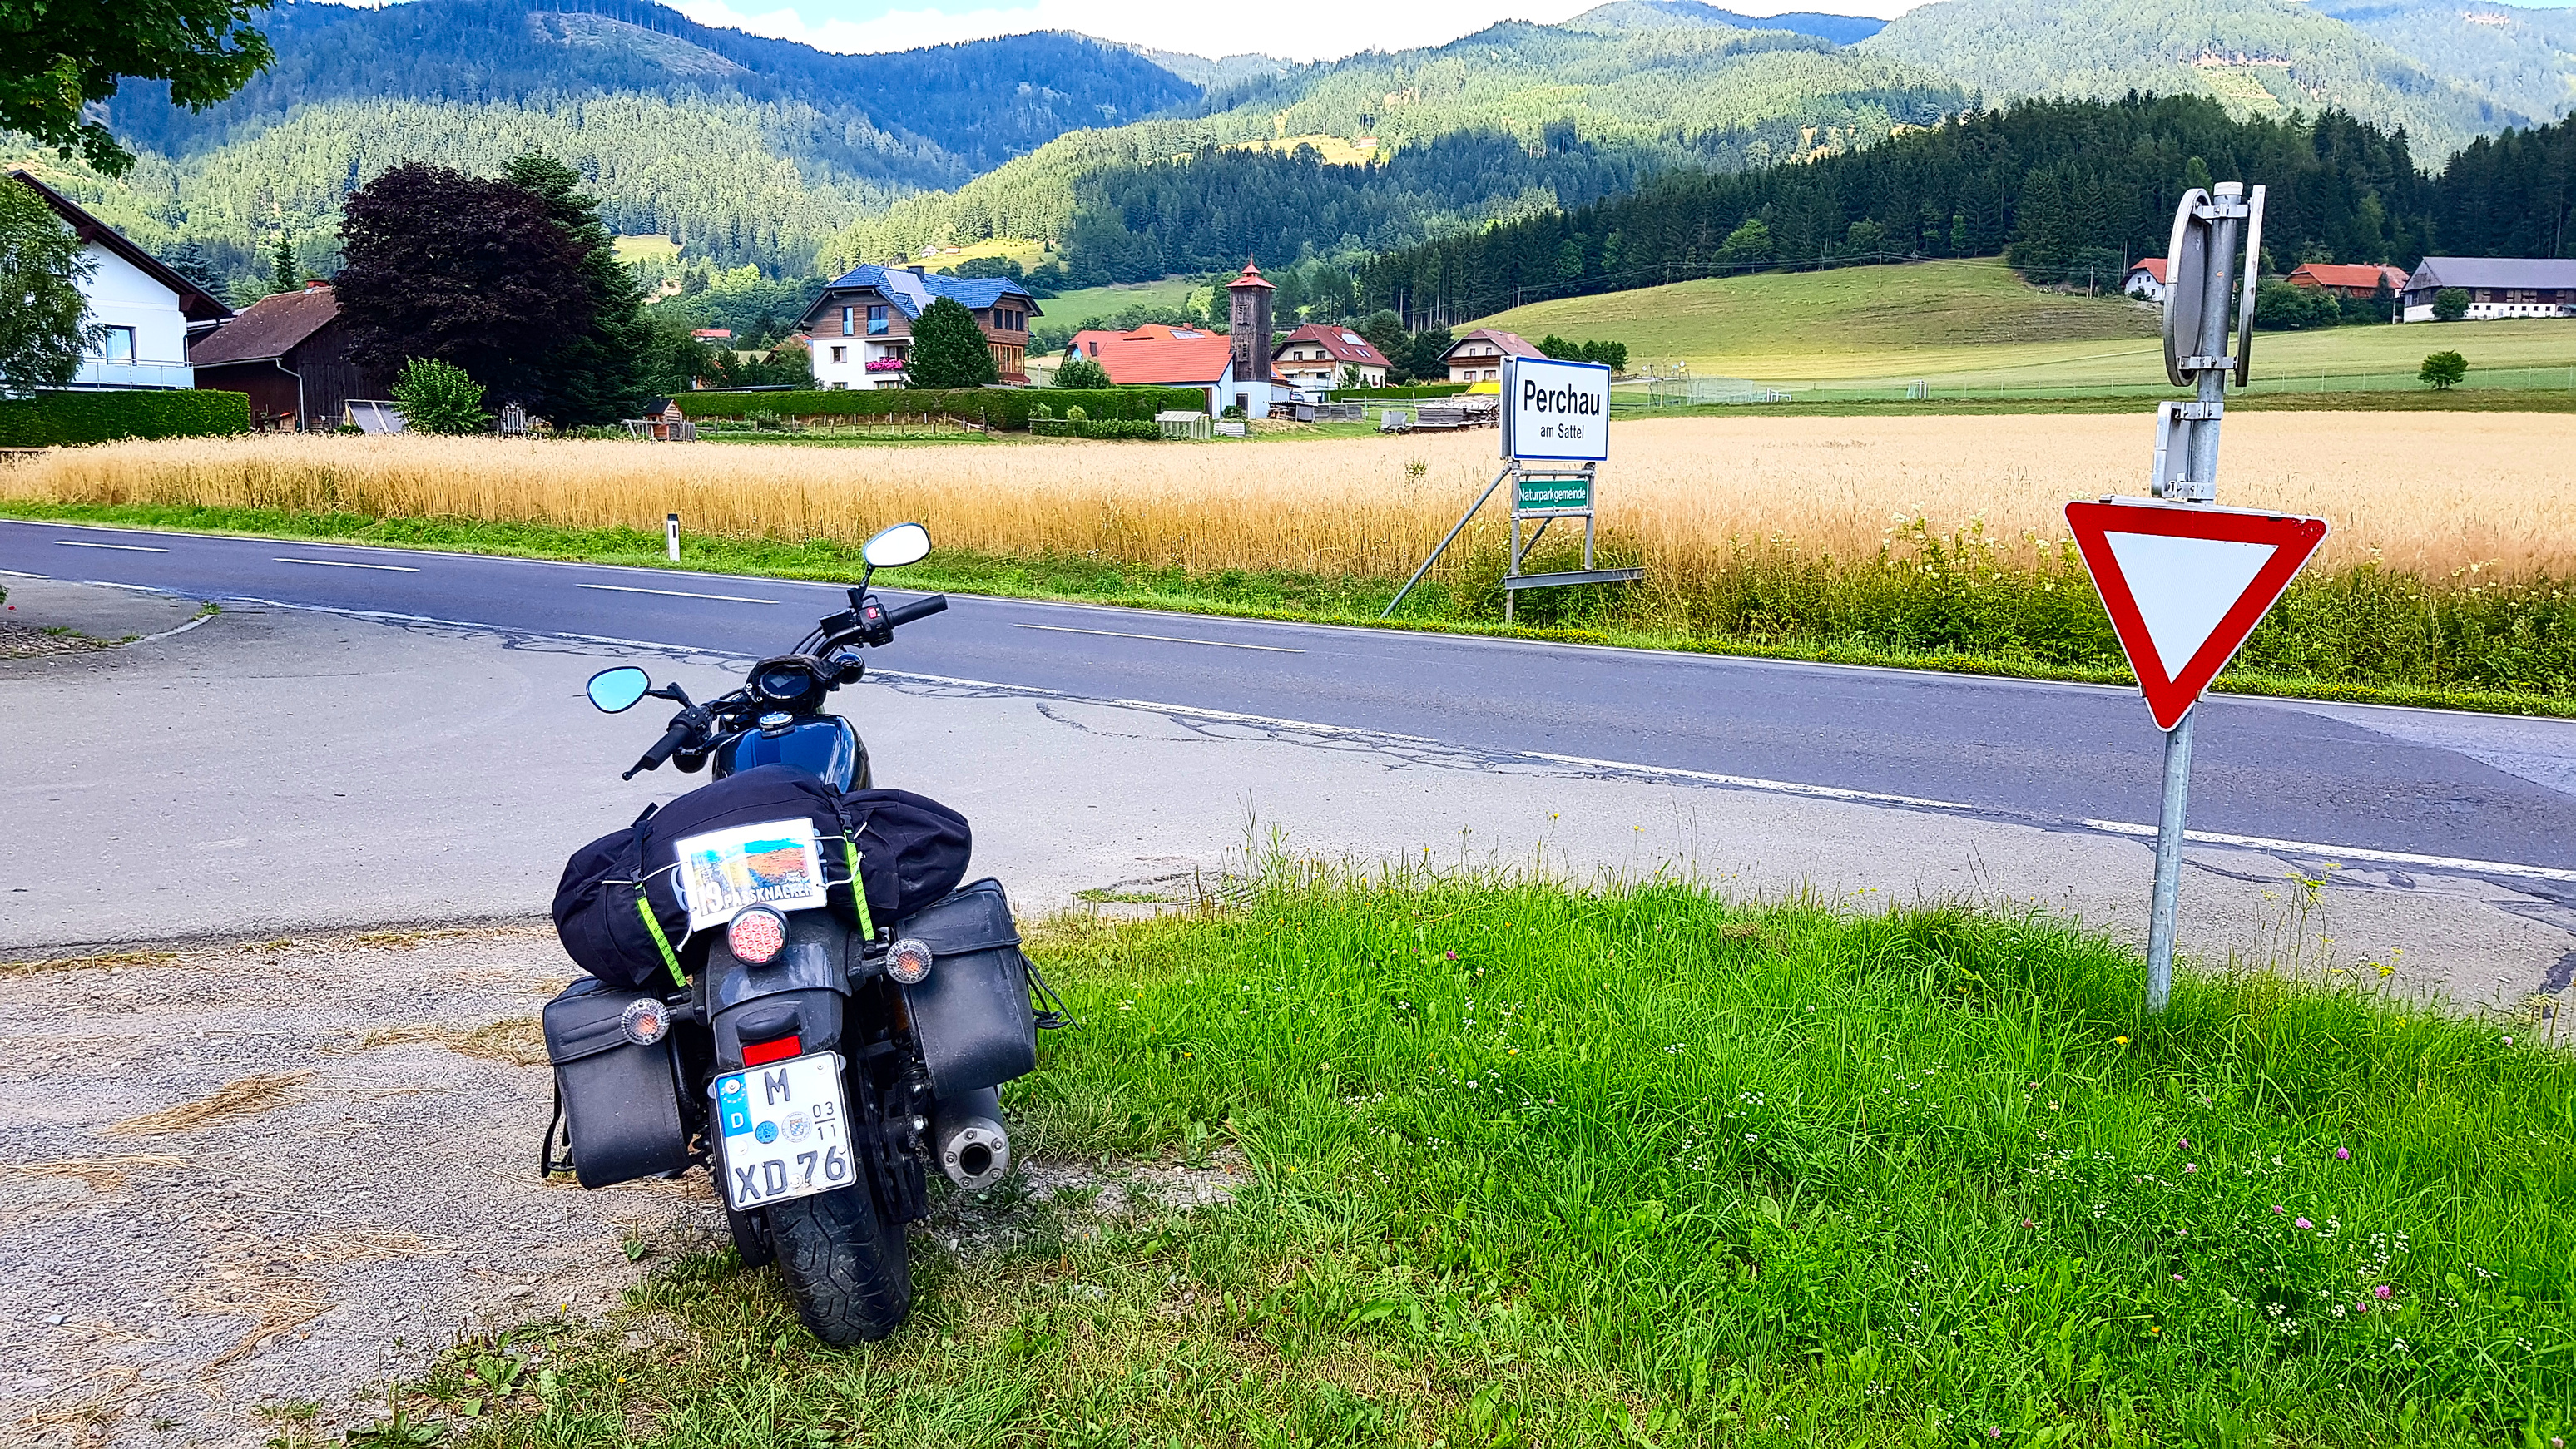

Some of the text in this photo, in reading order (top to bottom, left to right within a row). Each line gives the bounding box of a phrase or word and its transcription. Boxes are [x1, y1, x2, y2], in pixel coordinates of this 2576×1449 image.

[1523, 379, 1600, 416] Perchau
[1540, 423, 1585, 439] am Sattel
[1518, 486, 1586, 503] Naturparkgemeinde
[764, 1067, 790, 1105] M
[812, 1101, 835, 1118] 03
[731, 1112, 744, 1129] D
[817, 1124, 836, 1140] 11
[735, 1145, 846, 1203] XD 76
